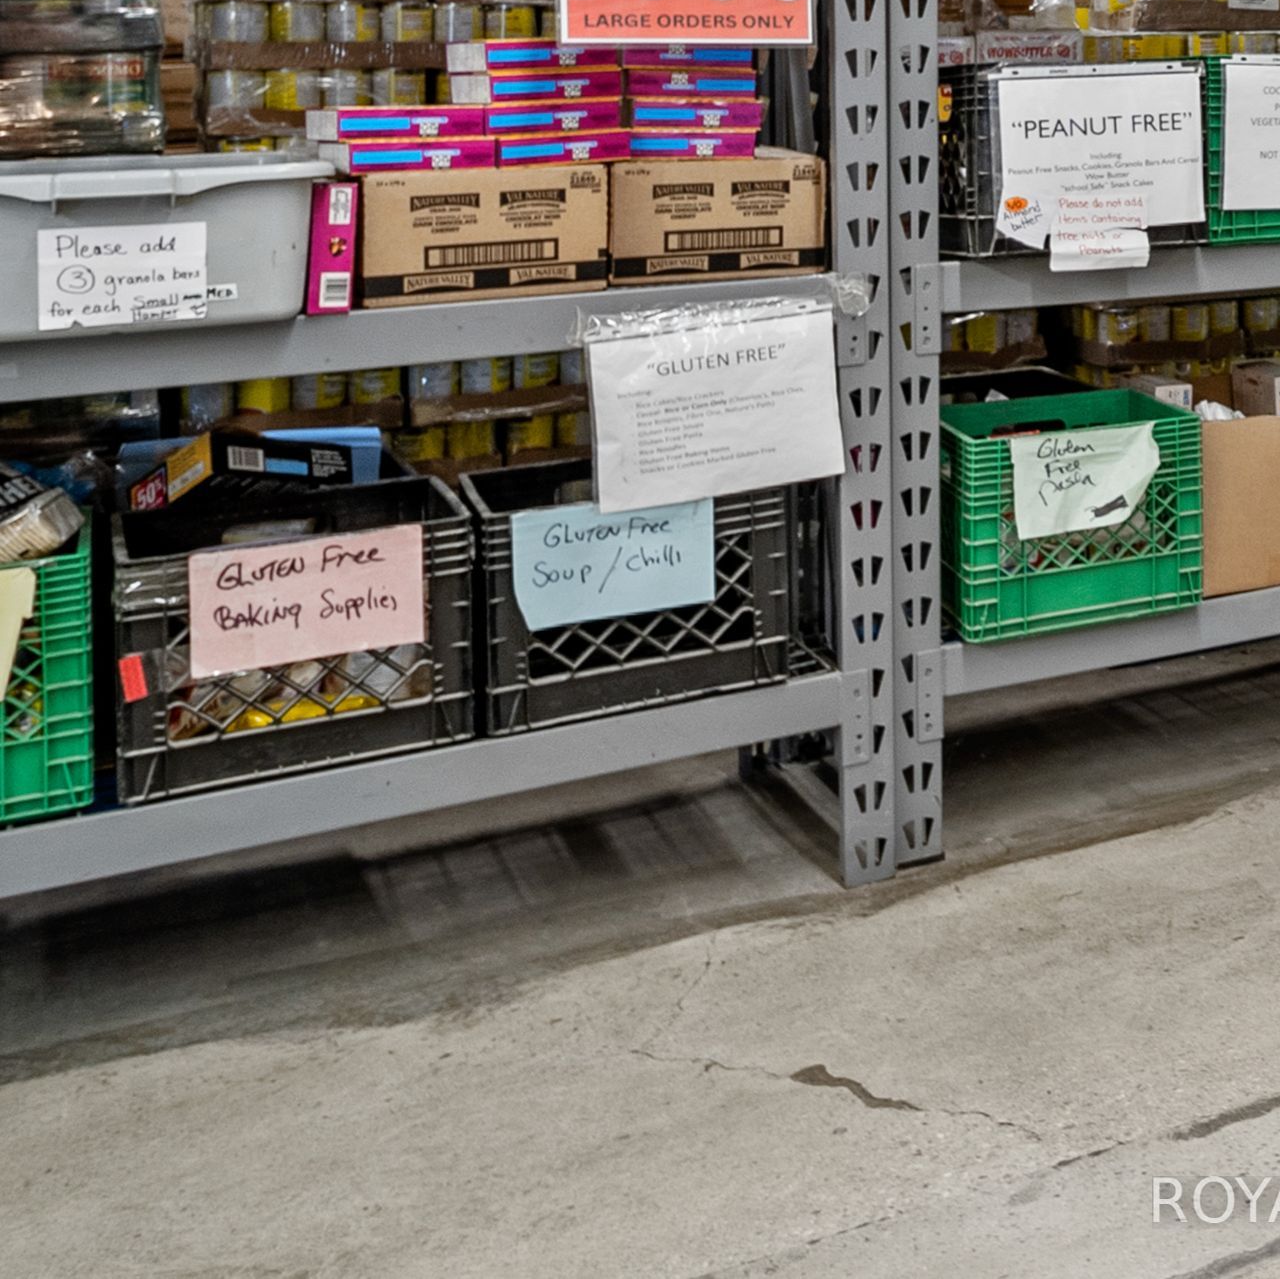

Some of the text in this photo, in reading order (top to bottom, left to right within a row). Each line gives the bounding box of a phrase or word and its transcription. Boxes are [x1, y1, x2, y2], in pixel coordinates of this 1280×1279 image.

[584, 14, 794, 29] LARGE ORDERS ONLY
[1260, 150, 1278, 159] NOT
[413, 193, 479, 210] NATURE VALLEY
[1058, 196, 1144, 209] Please do not add
[56, 235, 176, 258] Please add
[104, 269, 165, 296] granola
[173, 267, 200, 280] bars
[407, 267, 568, 289] NATURE VALLEY VAL NATURE
[49, 302, 73, 318] for
[82, 299, 121, 315] each
[133, 294, 179, 309] Small
[1036, 438, 1095, 459] Gluten
[1044, 460, 1082, 478] Free
[628, 518, 671, 538] Free
[217, 545, 387, 591] GLUTEN Free
[532, 561, 593, 588] Soup
[319, 585, 398, 620] Supplies
